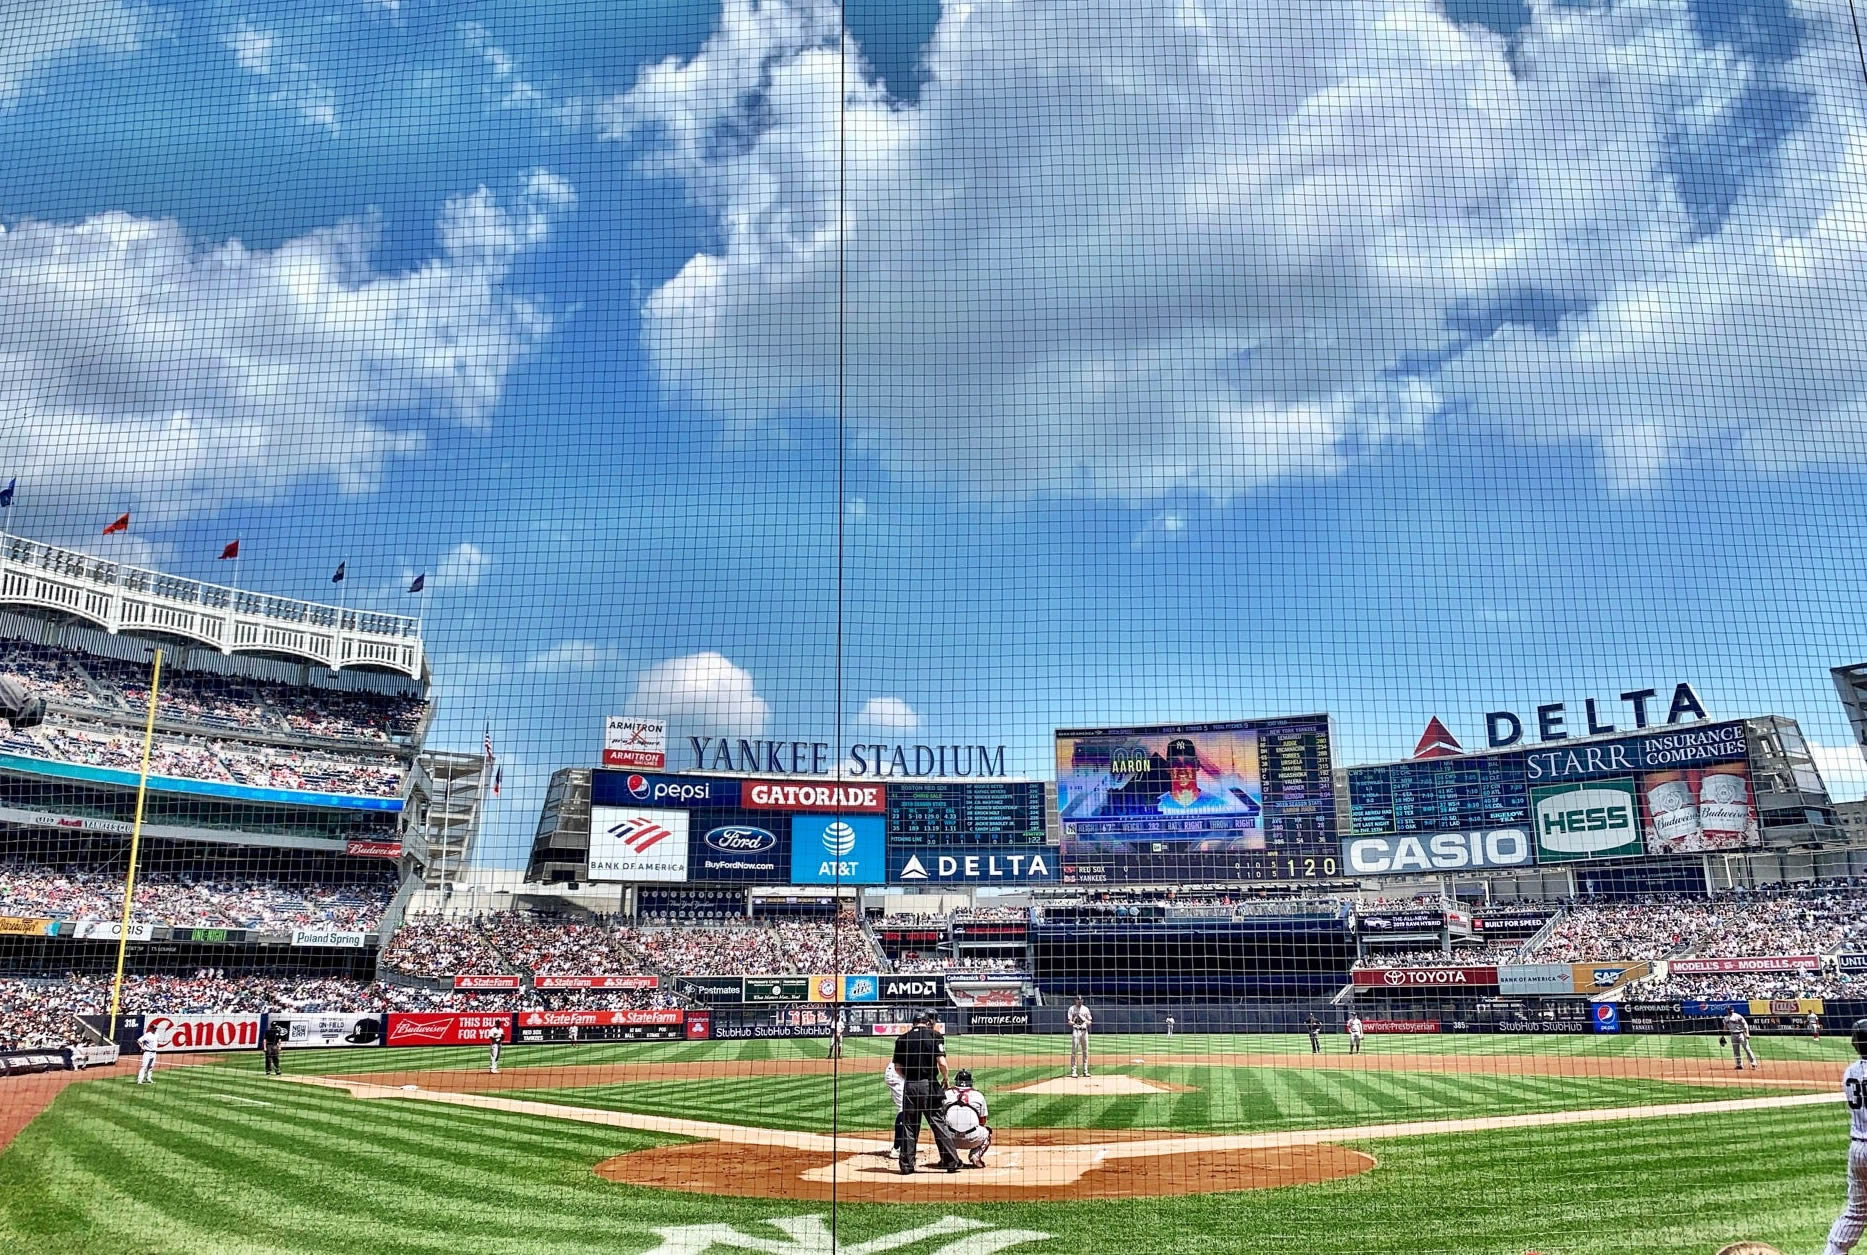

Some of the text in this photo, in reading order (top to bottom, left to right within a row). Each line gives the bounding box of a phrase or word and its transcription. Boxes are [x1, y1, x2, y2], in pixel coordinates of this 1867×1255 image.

[1486, 683, 1709, 747] DELTA
[609, 721, 663, 733] ARMITRON
[1645, 726, 1745, 752] INSURANCE
[610, 751, 660, 762] ARMITRON
[690, 735, 1007, 778] YANKEE STADIUM
[1647, 739, 1747, 764] COMPANIES
[1112, 760, 1151, 773] AARON
[1528, 743, 1634, 779] STARR
[655, 782, 711, 802] pepsi
[751, 785, 878, 807] GATORADE
[1184, 821, 1203, 829] RIGHT
[1235, 819, 1255, 828] RIGHT
[1544, 804, 1629, 835] HESS
[718, 830, 762, 850] Ford
[348, 843, 401, 855] Budweiser
[1350, 830, 1528, 872] CASIO
[590, 861, 685, 873] BANK OF AMERICA
[705, 860, 774, 871] BuyFordNow.com
[818, 861, 859, 876] AT&T
[938, 855, 1049, 876] DELTA
[1288, 859, 1295, 877] 1
[1304, 858, 1316, 876] 2
[1324, 858, 1336, 875] 0
[1485, 920, 1503, 928] BUILT
[297, 932, 360, 947] Poland Spring
[1673, 961, 1719, 971] MODELL'S
[1738, 959, 1814, 969] MODELLS.com
[1407, 970, 1467, 983] TOYOTA
[1594, 972, 1620, 984] SAP
[699, 985, 740, 994] Postmates
[887, 983, 923, 995] AMD
[1624, 1004, 1632, 1012] G
[1673, 1003, 1681, 1012] G
[459, 1017, 480, 1028] THIS
[971, 1015, 1028, 1024] NITTOTIRE.COM
[398, 1023, 447, 1034] Budweiser
[716, 1025, 831, 1038] StubHub StubHub StubHub
[1500, 1021, 1582, 1031] StubHub StubHub
[147, 1017, 257, 1048] Canon
[458, 1028, 491, 1039] FOR YO
